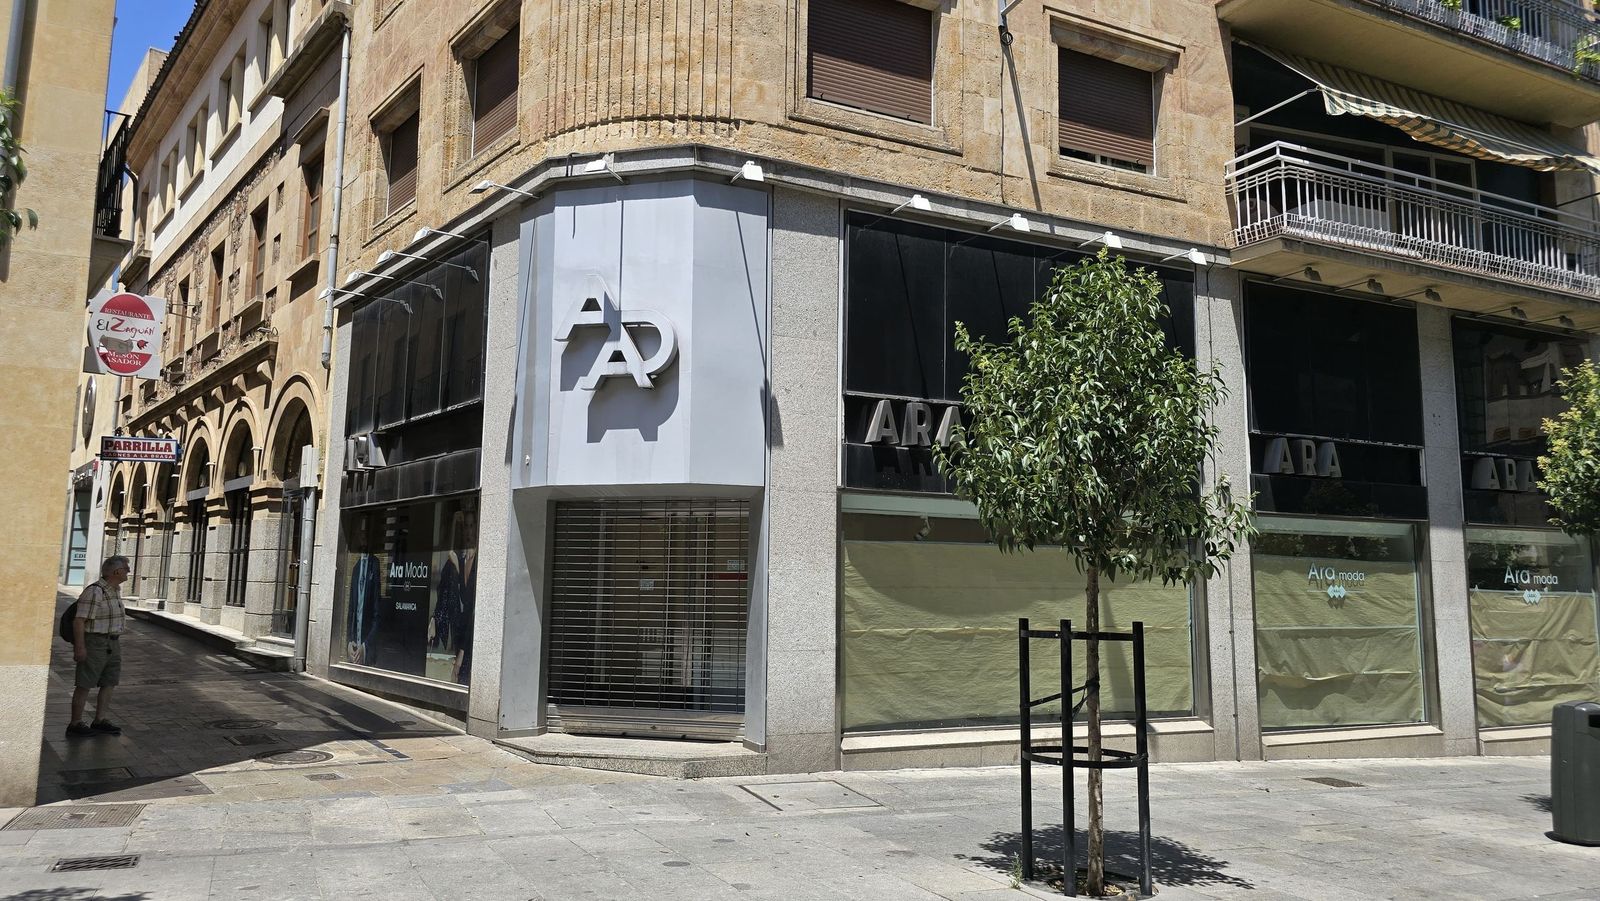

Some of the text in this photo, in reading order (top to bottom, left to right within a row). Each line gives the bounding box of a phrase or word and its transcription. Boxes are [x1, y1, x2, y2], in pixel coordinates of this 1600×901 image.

[105, 308, 150, 320] RESTAURANTE
[96, 318, 110, 331] El
[106, 356, 142, 366] ASADOR
[104, 440, 172, 452] PARRILLA
[1262, 437, 1343, 478] ARA
[1472, 456, 1538, 492] ARA
[389, 561, 428, 578] Ara Moda
[1308, 562, 1365, 581] Ara moda
[1504, 565, 1559, 585] Ara moda
[395, 602, 417, 611] SALAMANCA
